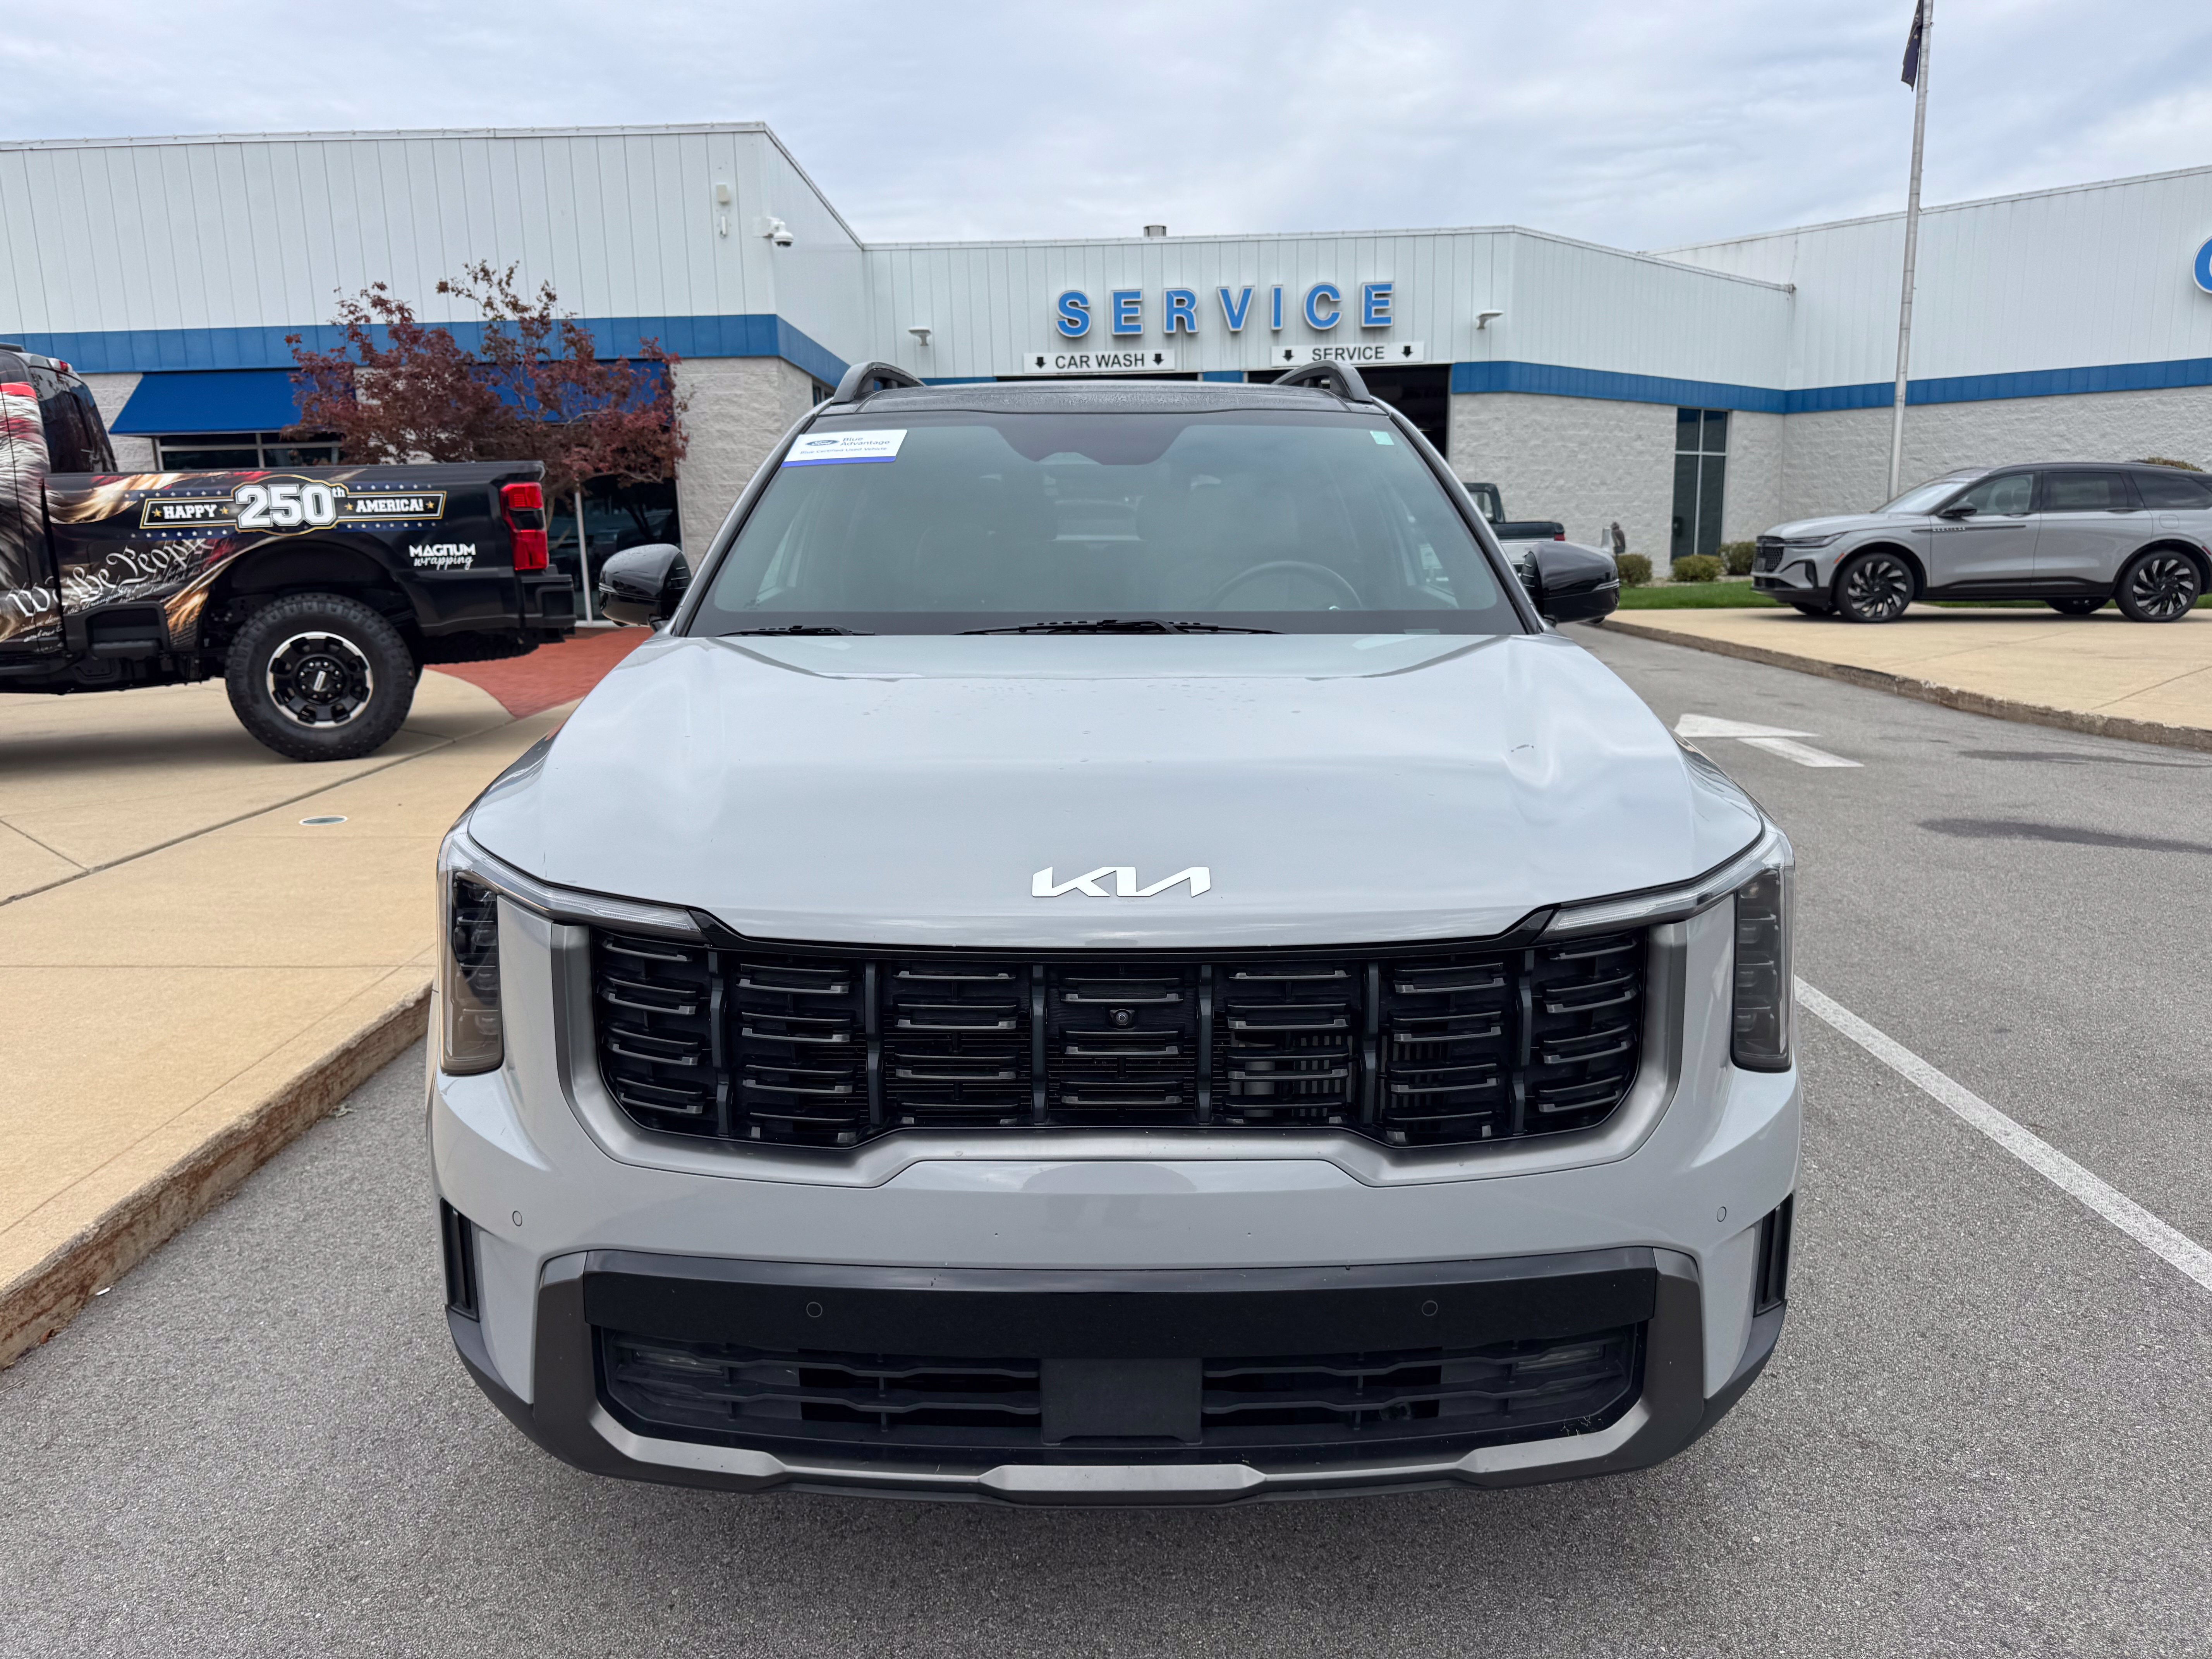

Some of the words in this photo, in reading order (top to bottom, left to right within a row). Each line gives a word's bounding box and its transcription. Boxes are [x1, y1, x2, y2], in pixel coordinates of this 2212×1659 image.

[1054, 282, 1394, 338] SERVICE
[1055, 355, 1091, 369] CAR
[1096, 353, 1145, 368] WASH
[1311, 346, 1385, 361] SERVICE
[163, 504, 218, 519] HAPPY
[356, 498, 424, 513] AMERICA!
[409, 543, 477, 558] MAGNUM
[414, 555, 474, 570] wrapping
